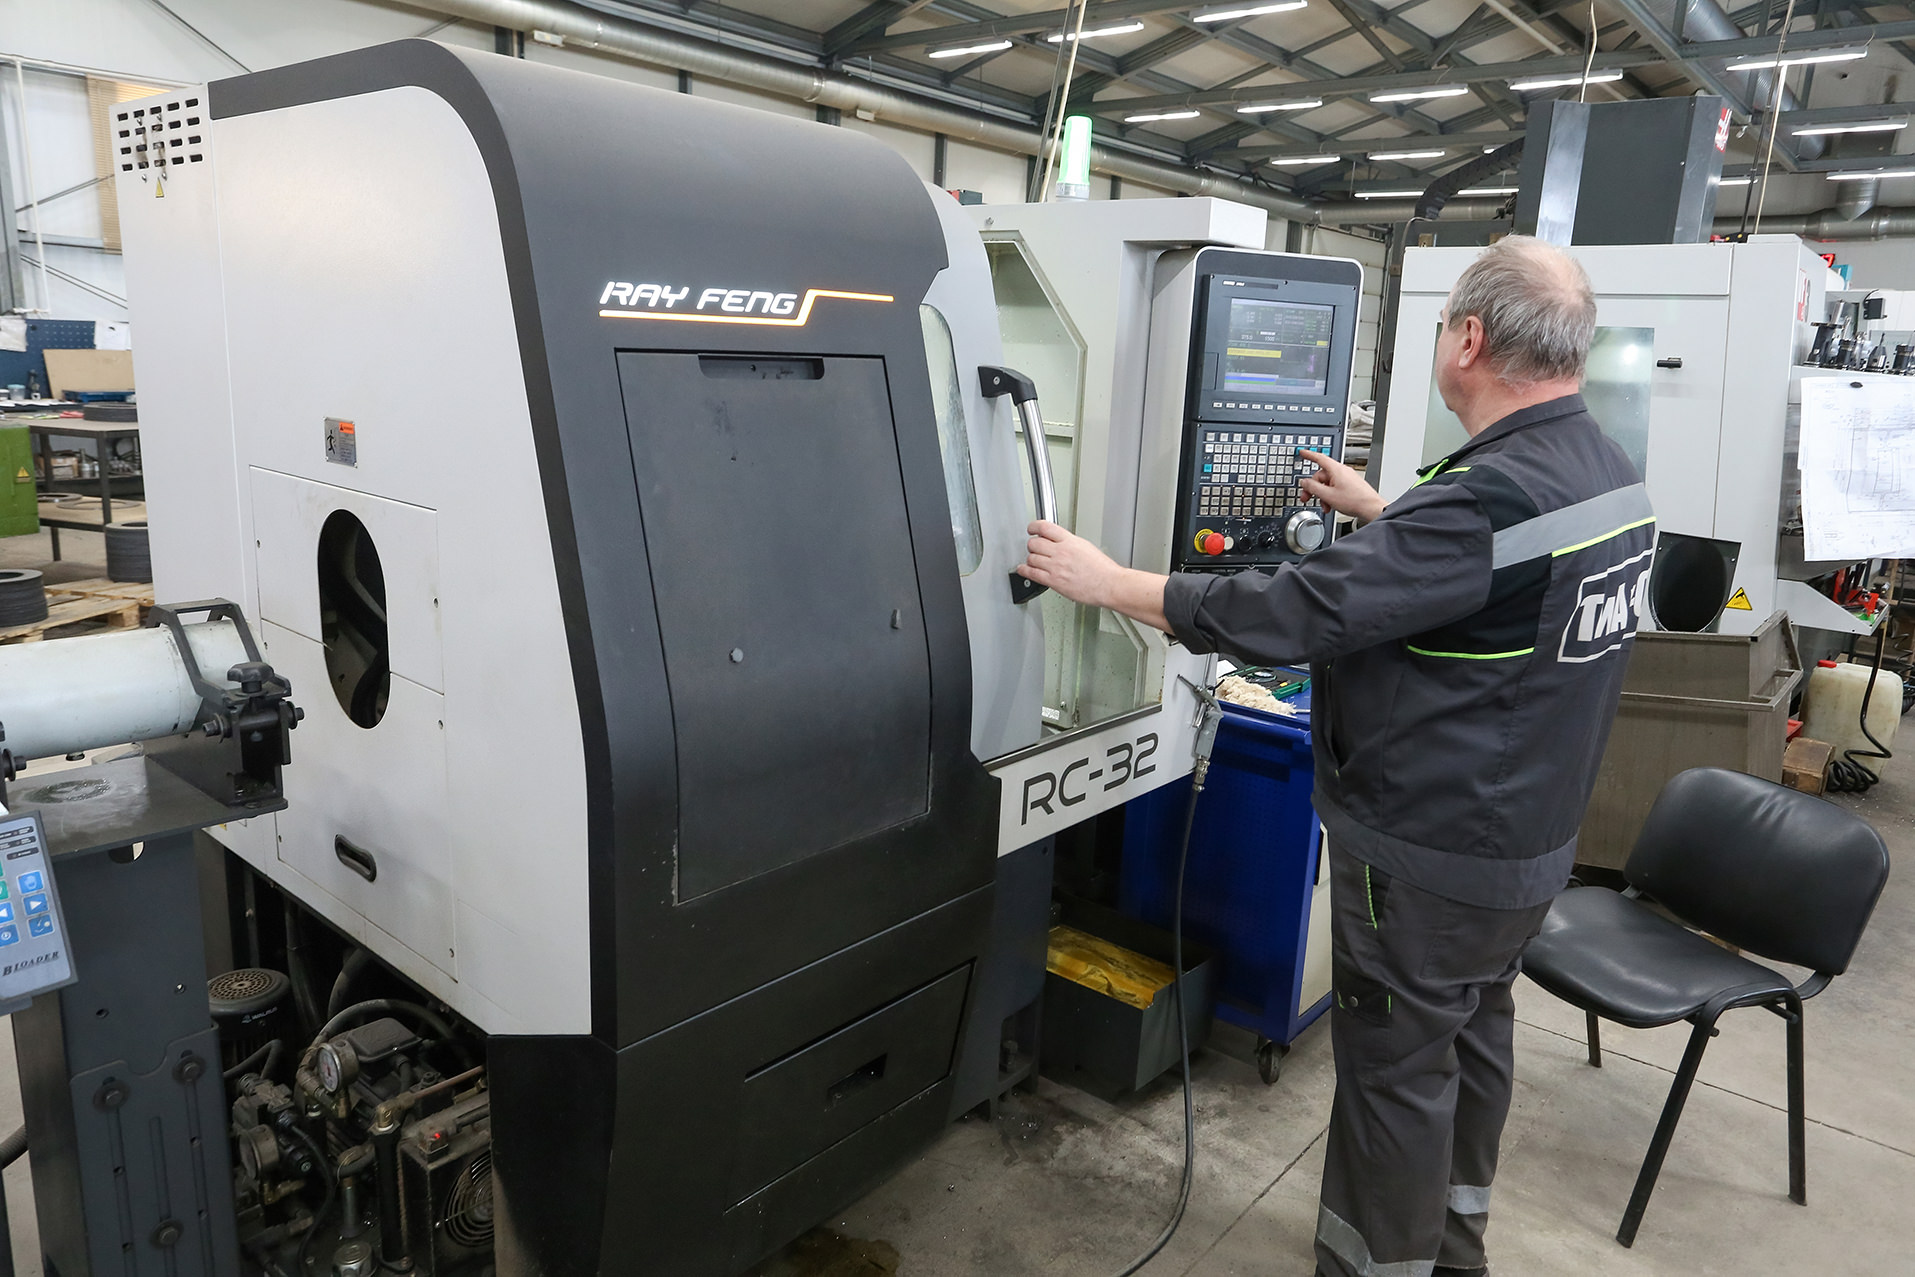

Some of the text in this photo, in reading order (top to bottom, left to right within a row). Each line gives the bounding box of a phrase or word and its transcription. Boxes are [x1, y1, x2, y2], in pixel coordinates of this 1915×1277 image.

[600, 281, 798, 315] RAY FENG
[1021, 732, 1159, 826] RC-32
